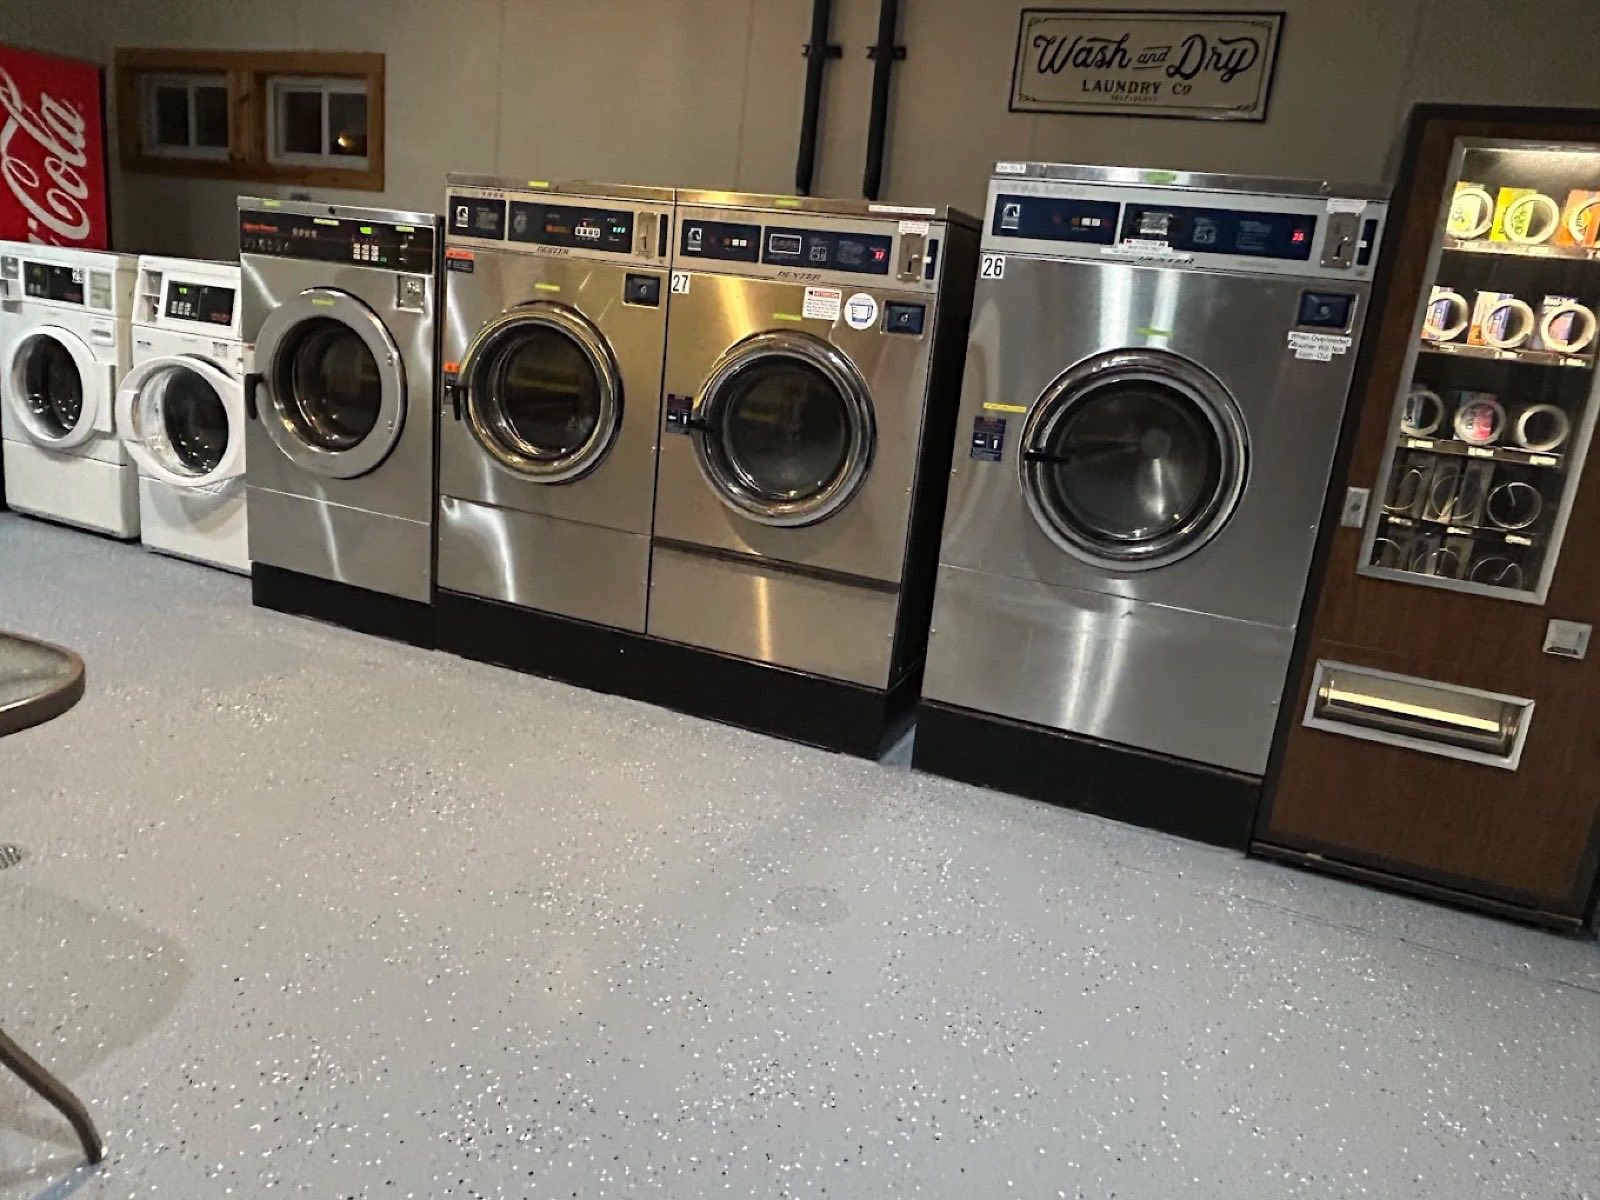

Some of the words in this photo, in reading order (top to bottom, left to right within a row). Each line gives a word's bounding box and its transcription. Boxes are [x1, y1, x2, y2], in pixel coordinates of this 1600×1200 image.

[1033, 33, 1132, 75] Wash
[1136, 46, 1172, 65] and
[1166, 33, 1259, 83] Dry
[1081, 79, 1162, 95] LAUNDRY
[983, 257, 1003, 276] 26
[672, 274, 689, 292] 27
